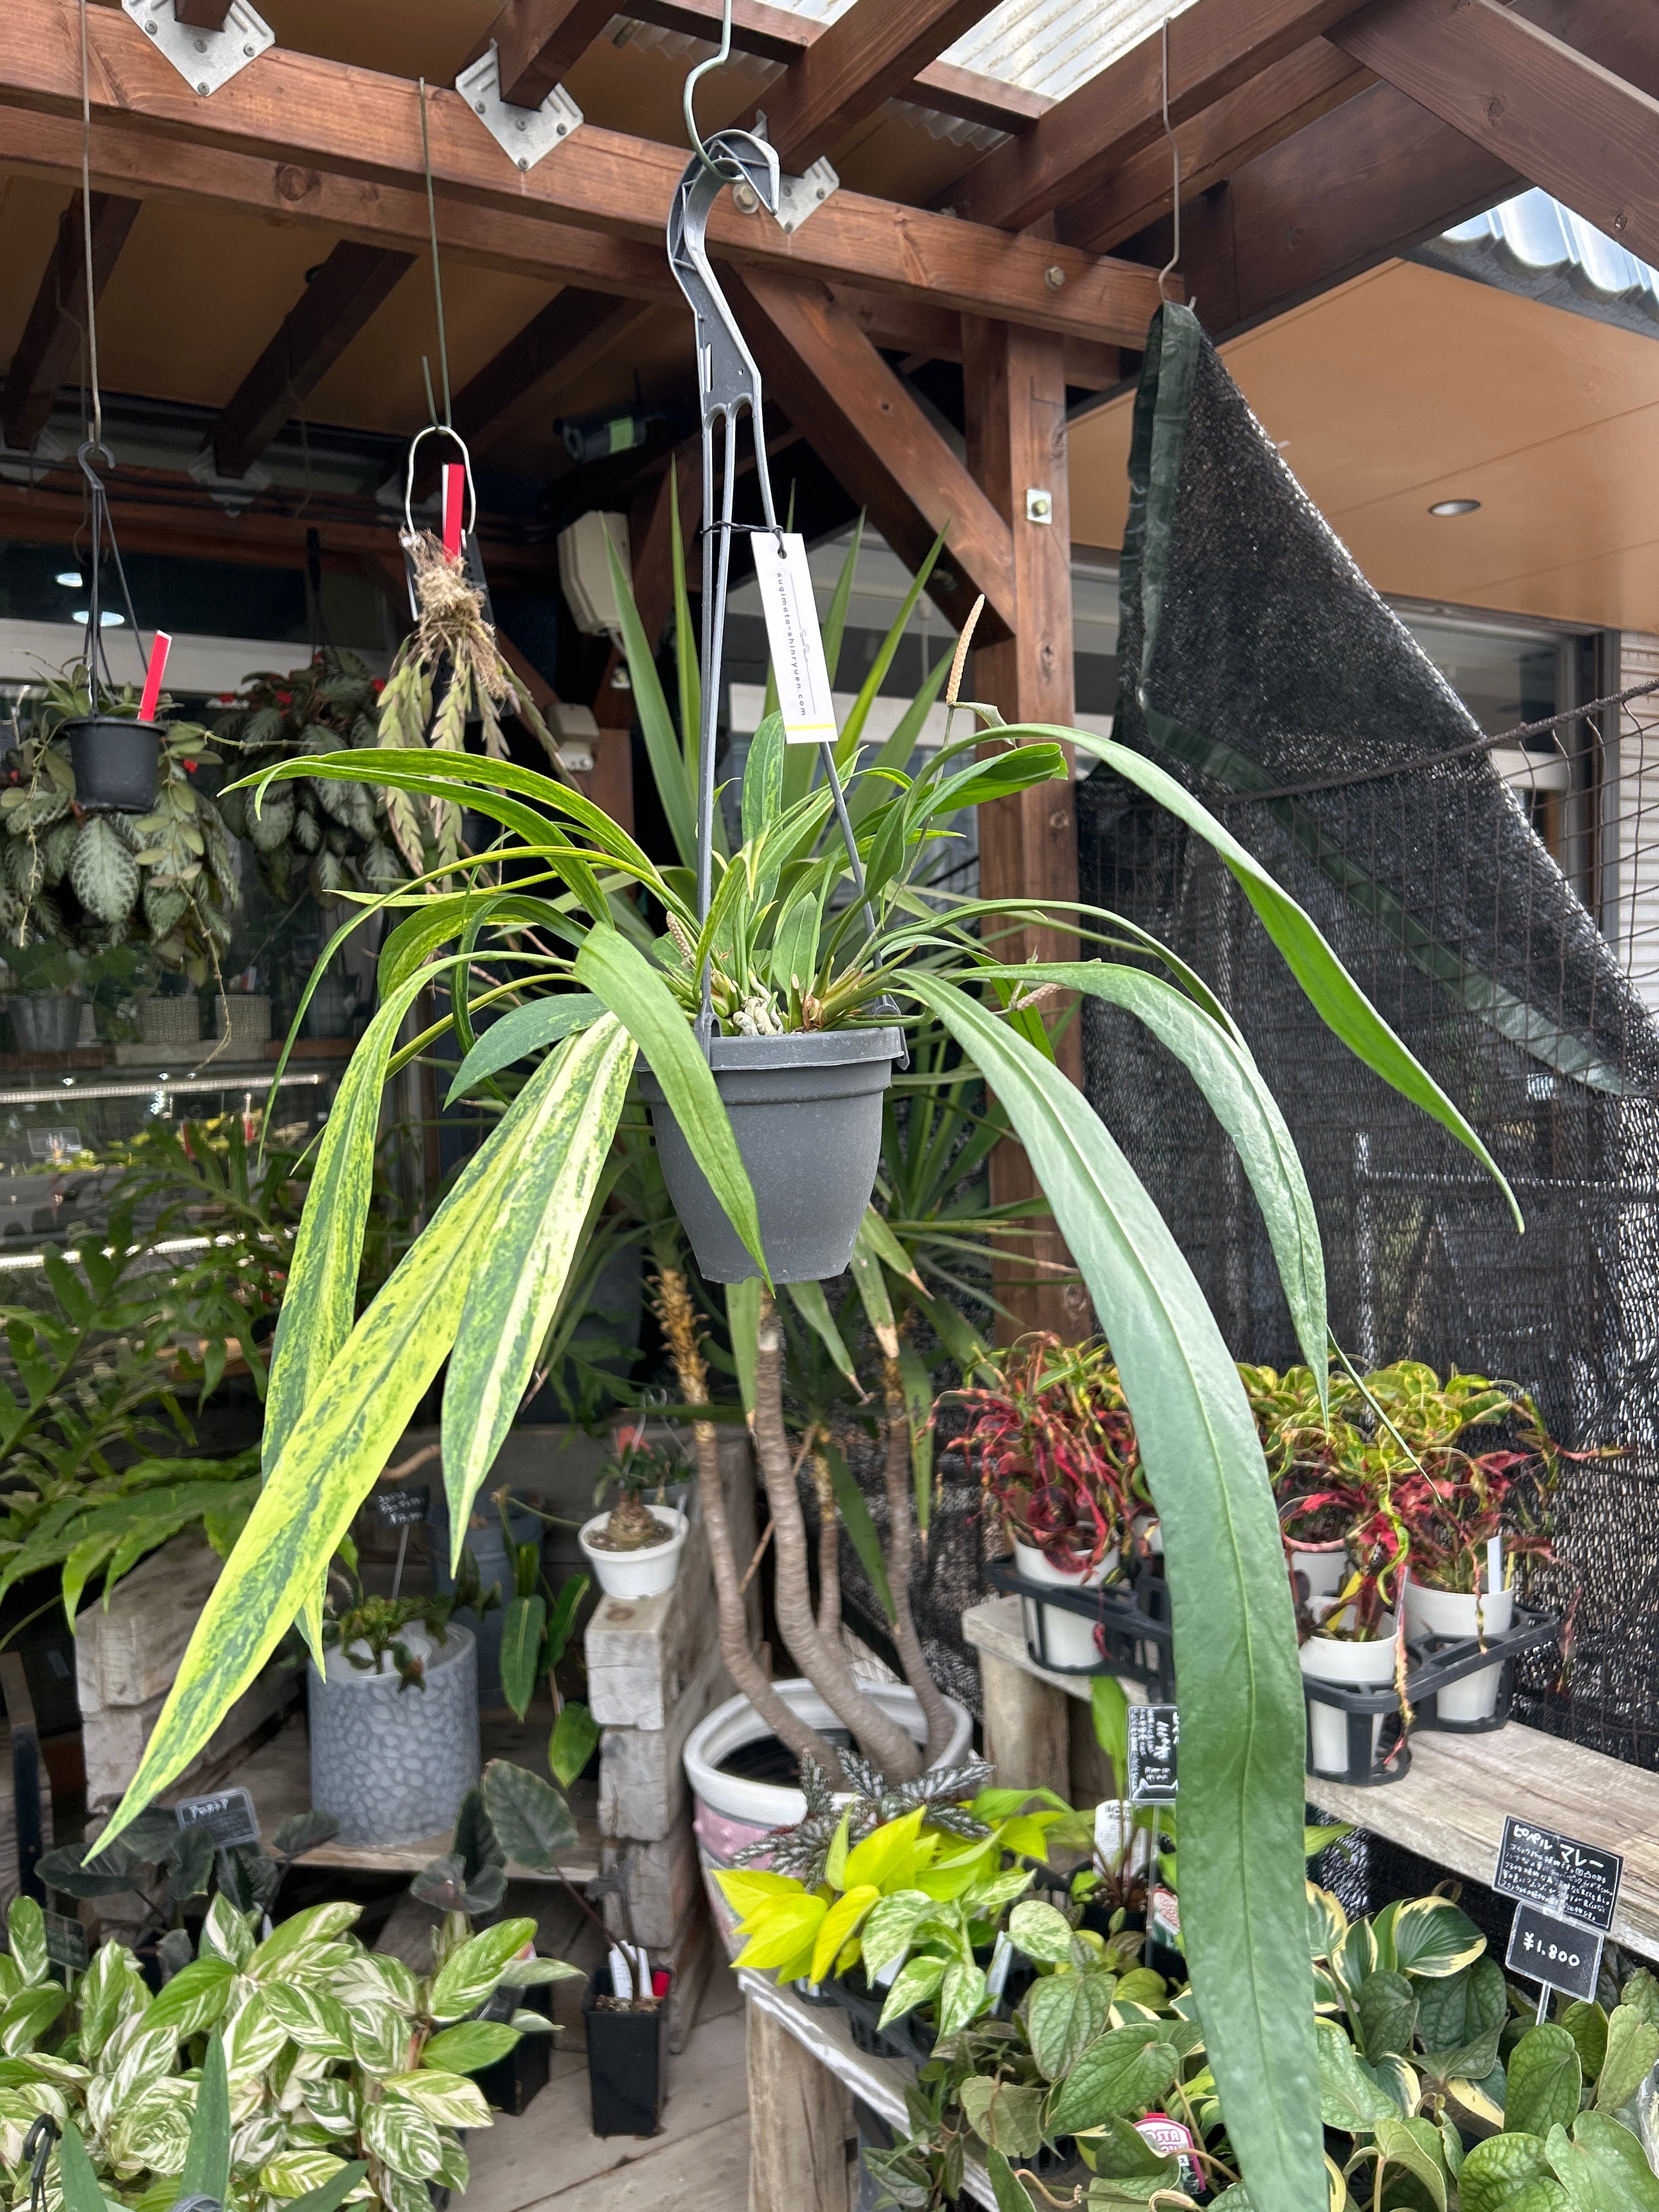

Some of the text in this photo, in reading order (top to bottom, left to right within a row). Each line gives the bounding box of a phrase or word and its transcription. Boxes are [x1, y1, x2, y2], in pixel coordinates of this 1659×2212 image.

[776, 572, 805, 716] sugimoto-shinryuen.com
[1513, 1824, 1604, 1868] ピペル マレー
[1139, 2129, 1181, 2143] OSTA
